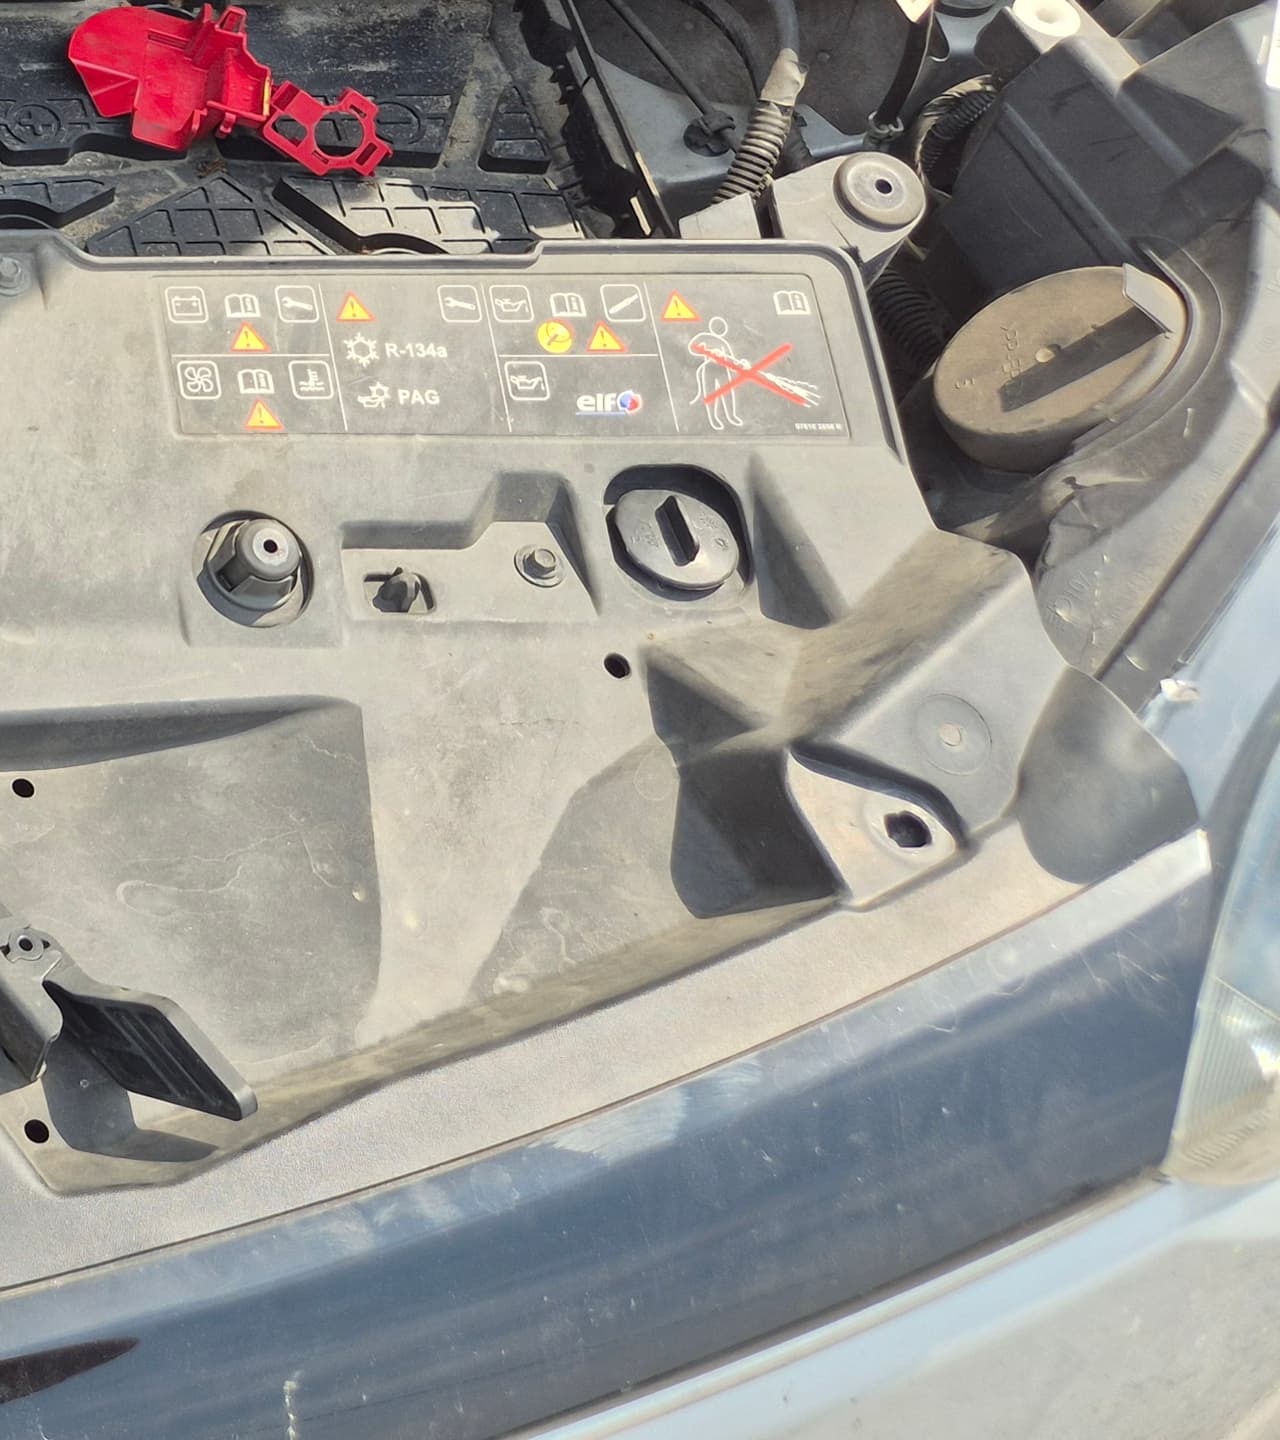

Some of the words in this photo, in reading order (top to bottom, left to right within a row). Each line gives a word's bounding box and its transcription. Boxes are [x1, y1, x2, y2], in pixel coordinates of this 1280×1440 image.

[384, 342, 449, 359] R-134a
[396, 389, 441, 406] PAG
[576, 392, 618, 412] elf
